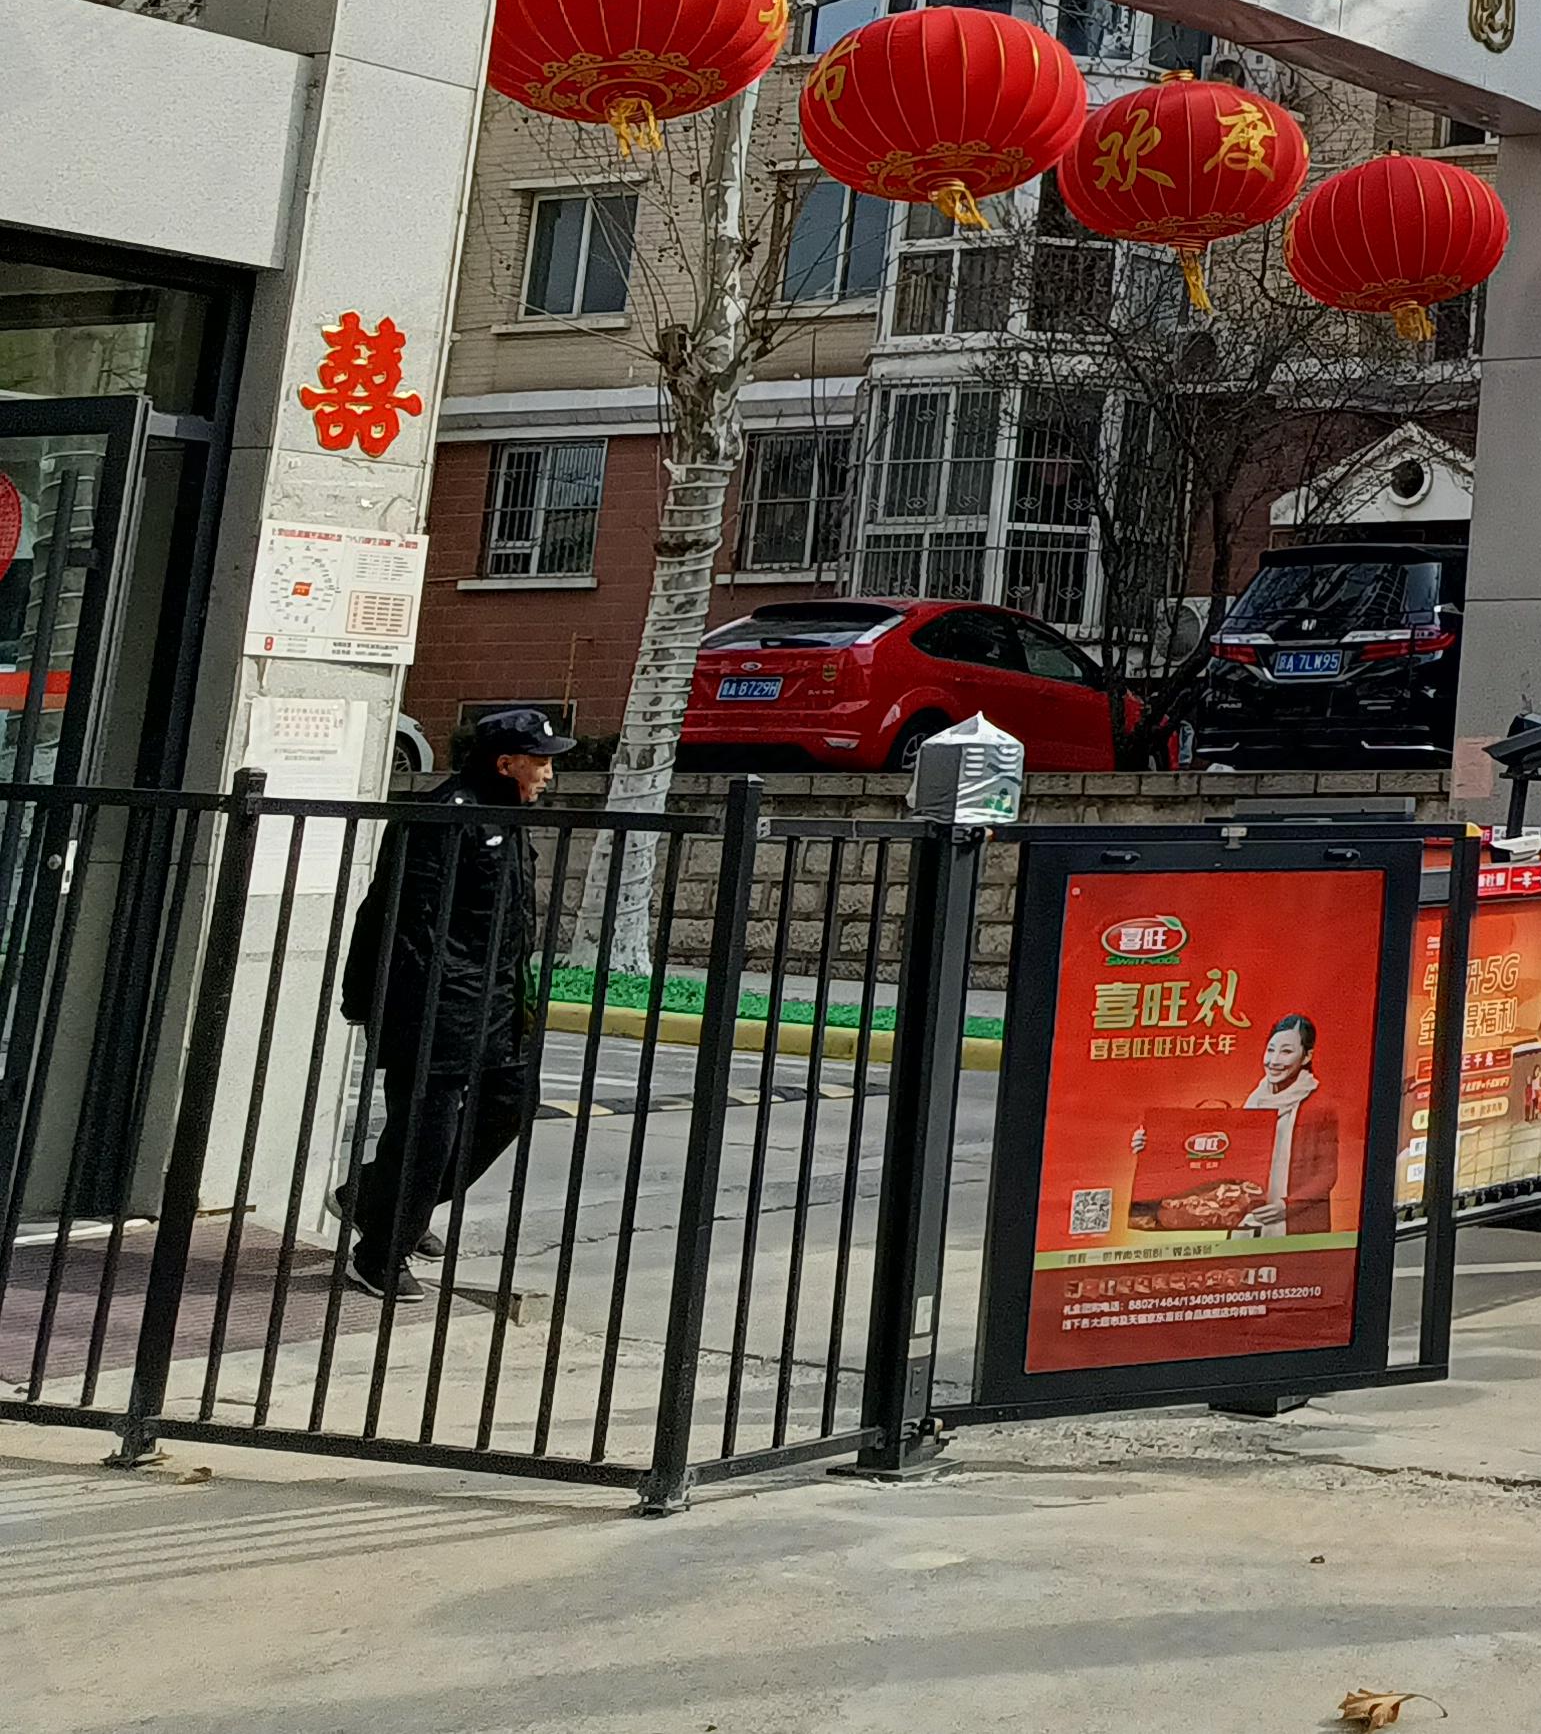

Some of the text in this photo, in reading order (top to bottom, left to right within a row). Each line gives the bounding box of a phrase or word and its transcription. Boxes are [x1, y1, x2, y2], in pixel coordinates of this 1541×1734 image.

[1119, 926, 1168, 951] 喜旺
[1091, 968, 1252, 1030] 喜旺礼
[1090, 1033, 1238, 1060] 喜喜旺旺过大年
